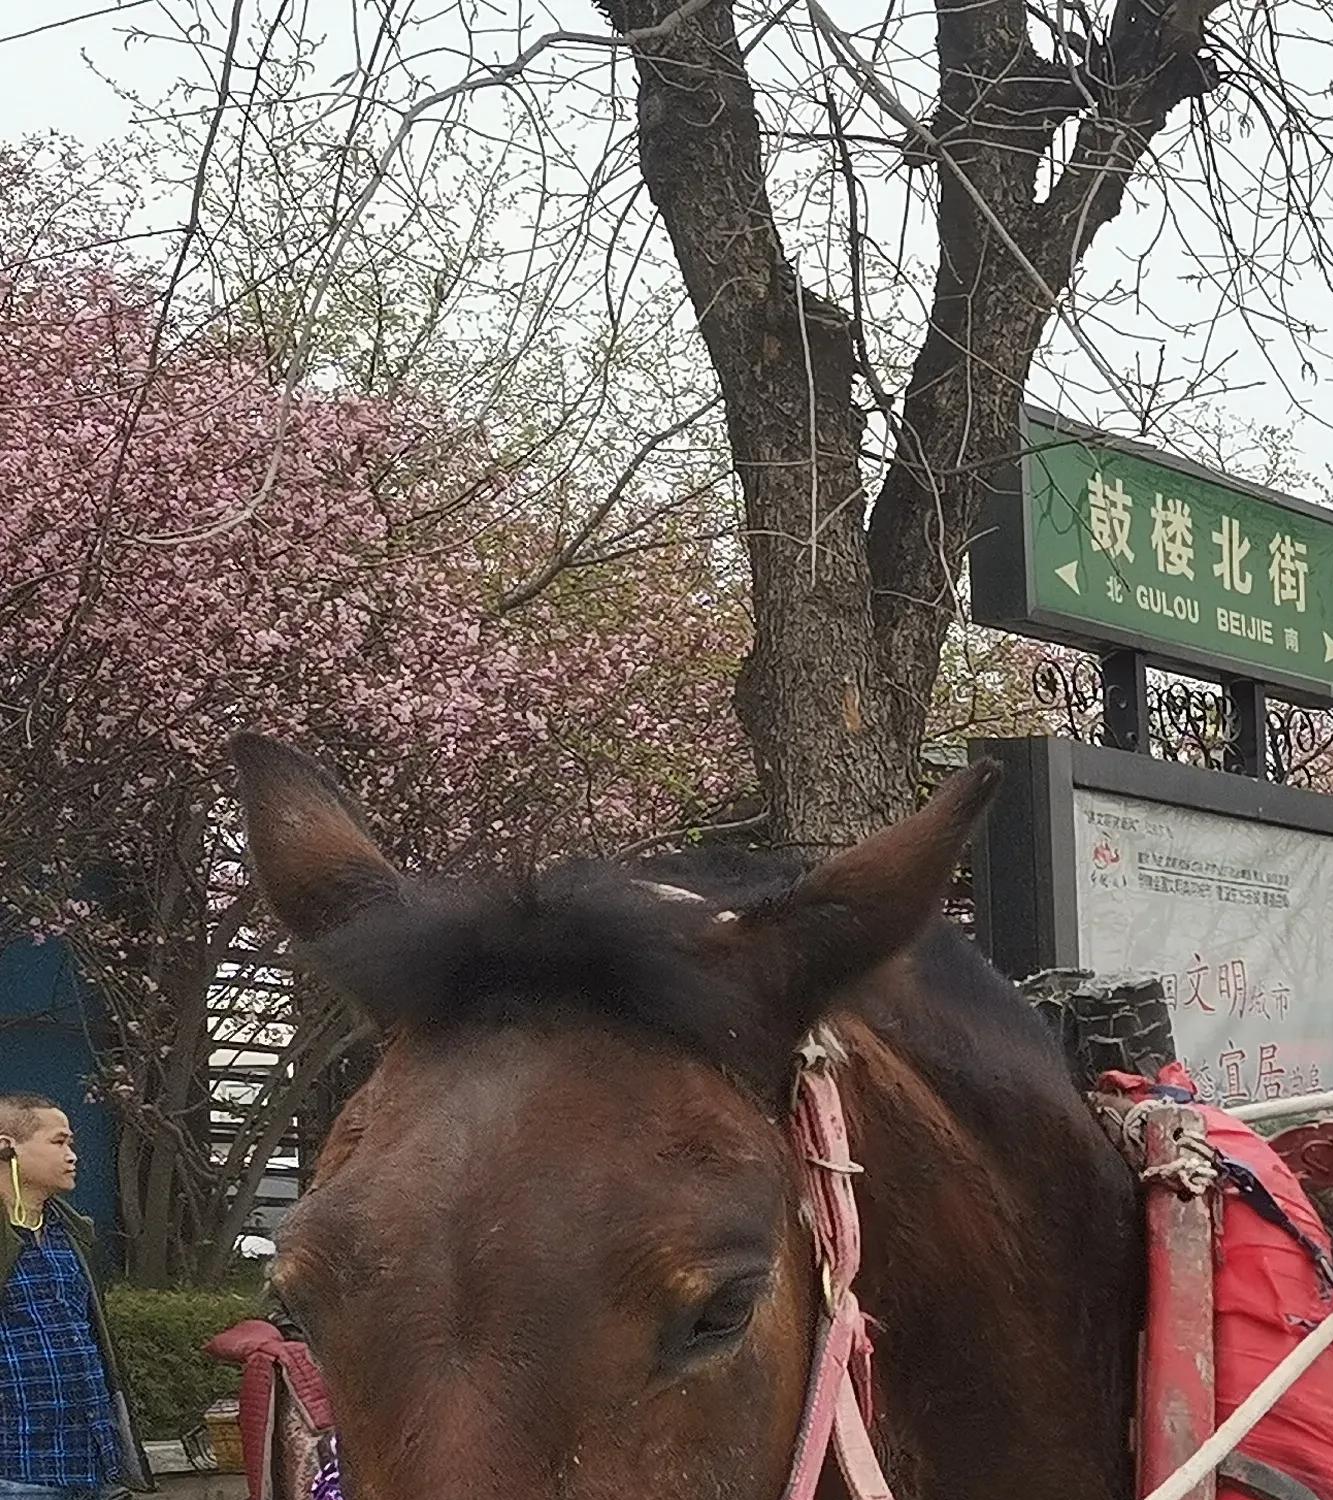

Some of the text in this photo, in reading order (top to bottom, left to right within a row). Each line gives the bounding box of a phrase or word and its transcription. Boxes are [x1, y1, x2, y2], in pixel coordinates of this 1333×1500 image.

[1088, 472, 1308, 612] 鼓楼北街
[1106, 576, 1299, 653] 北 GULOU BEIJIE 南
